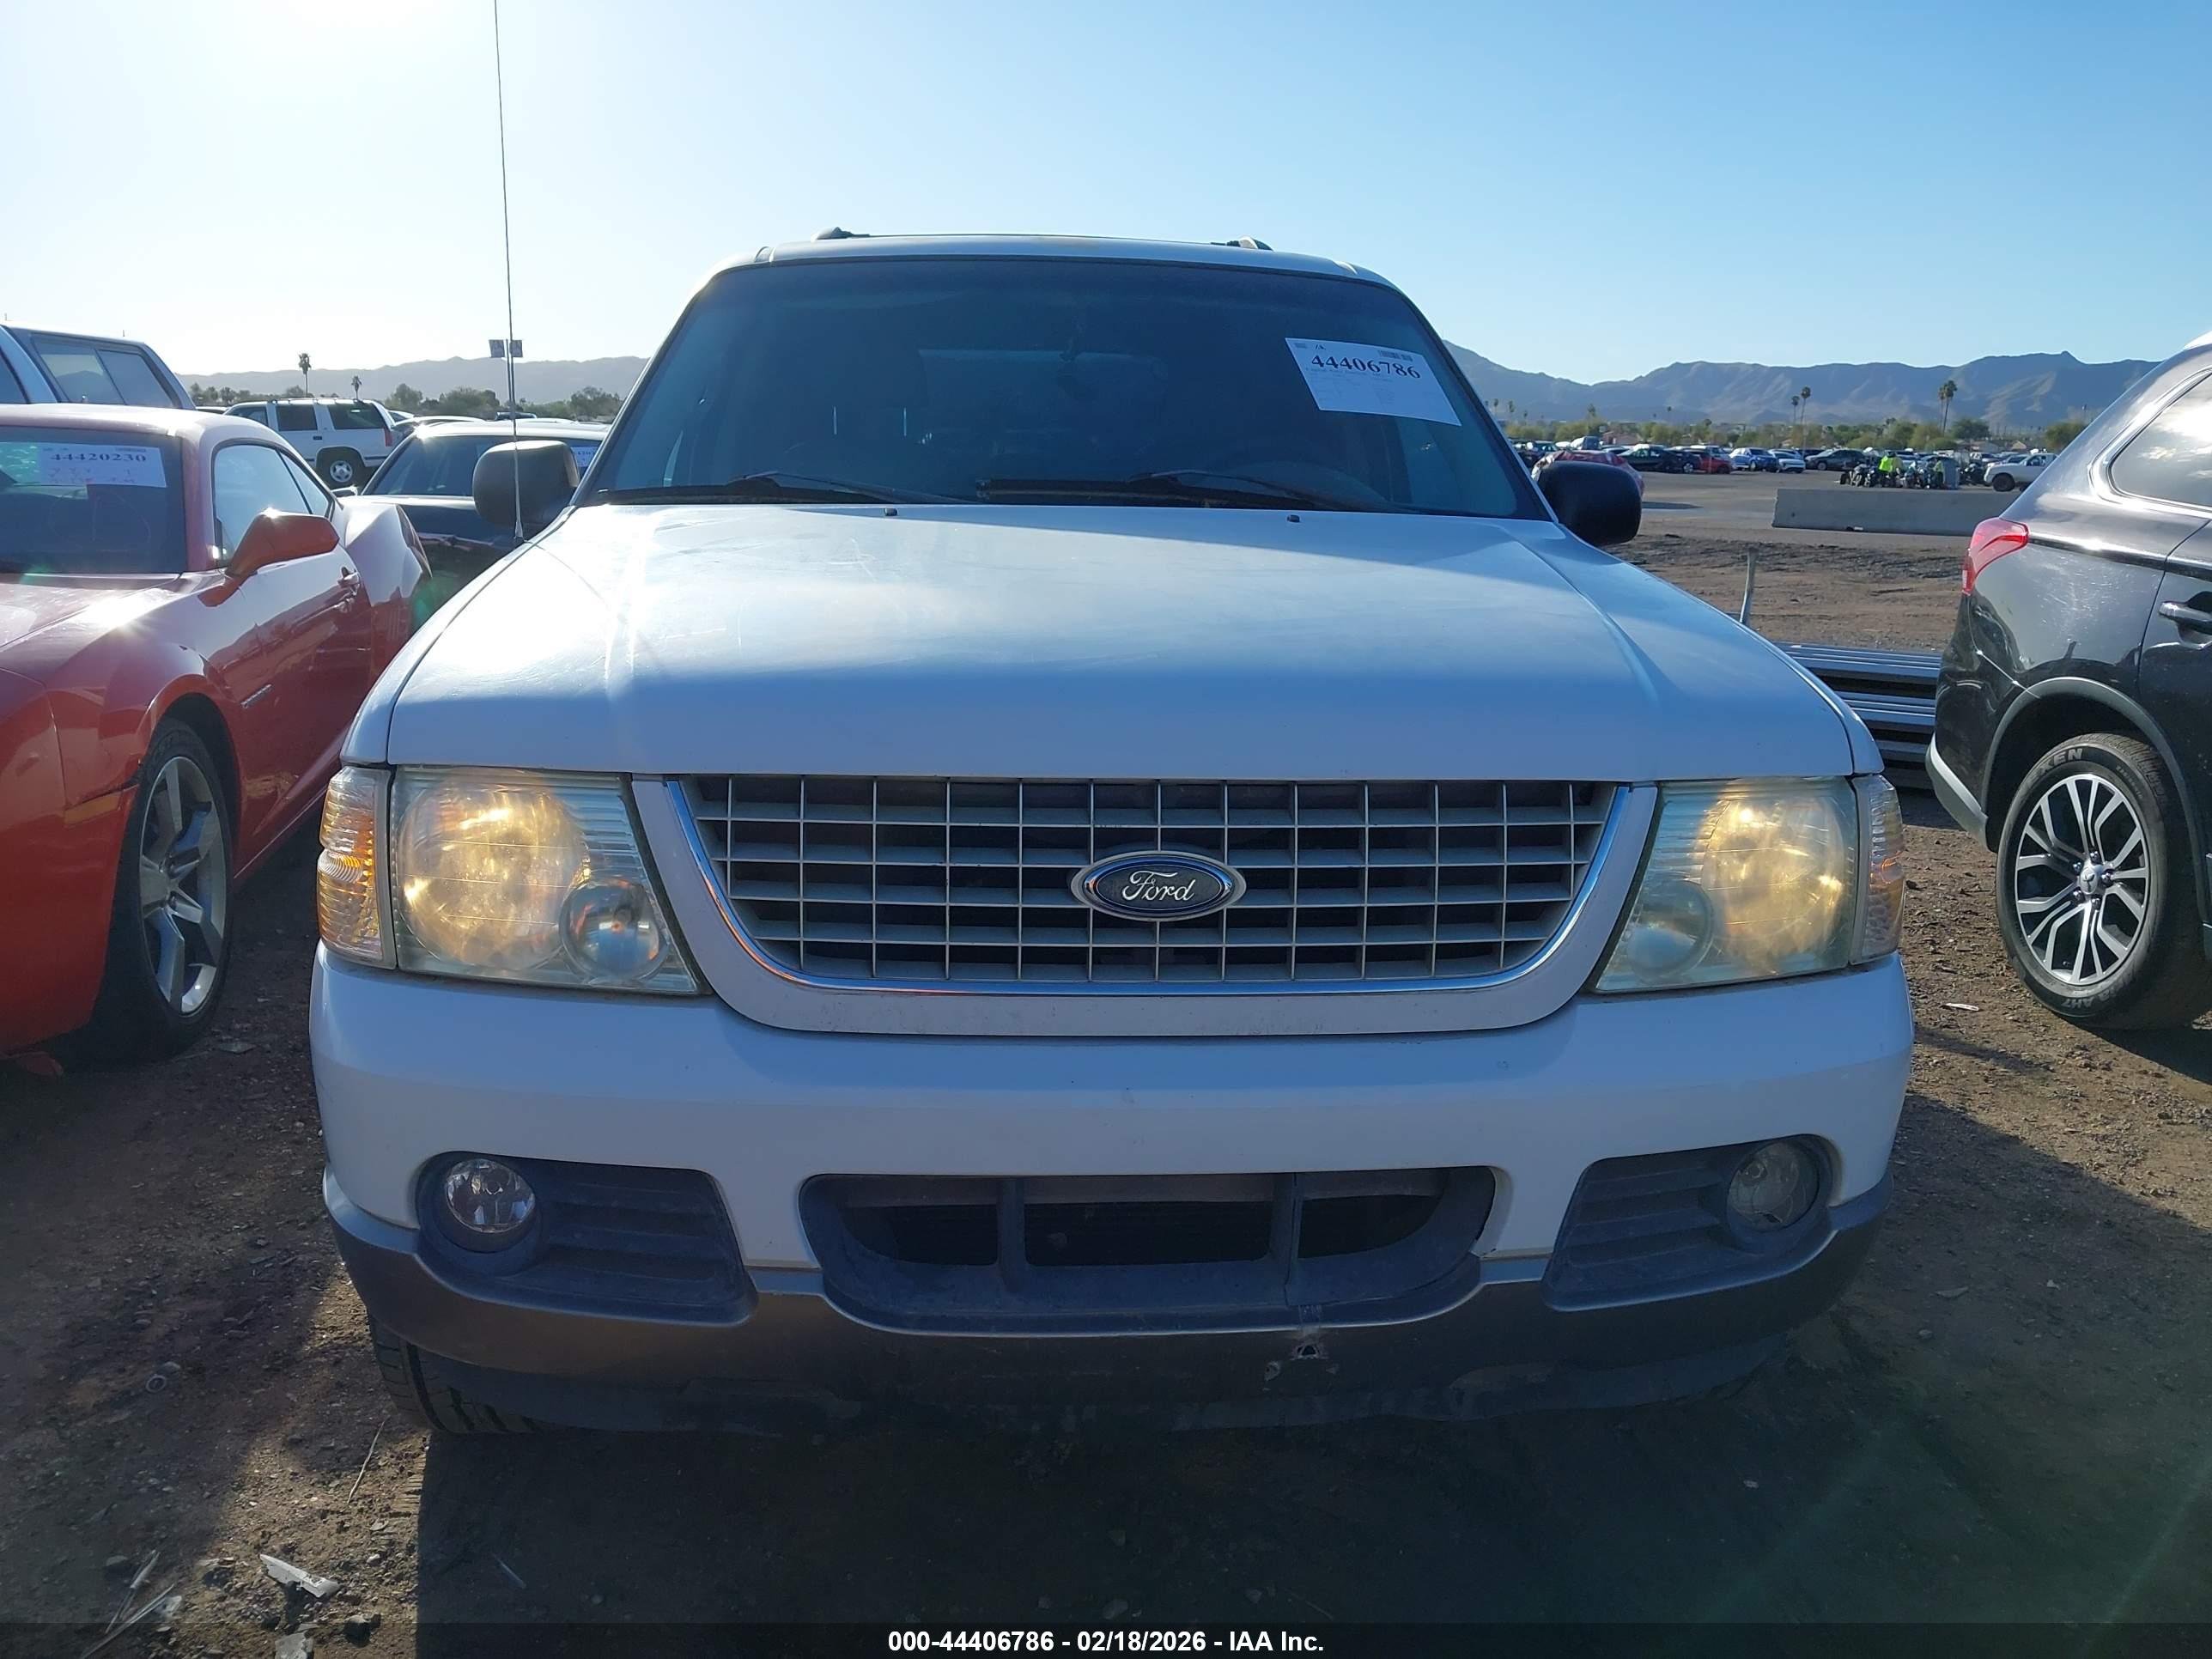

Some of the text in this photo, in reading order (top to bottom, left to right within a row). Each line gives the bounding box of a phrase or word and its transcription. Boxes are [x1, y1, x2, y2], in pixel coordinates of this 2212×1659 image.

[1311, 355, 1421, 379] 44406786
[50, 453, 147, 462] 44420230
[2023, 748, 2083, 787] EXEN
[1122, 870, 1196, 901] Ford
